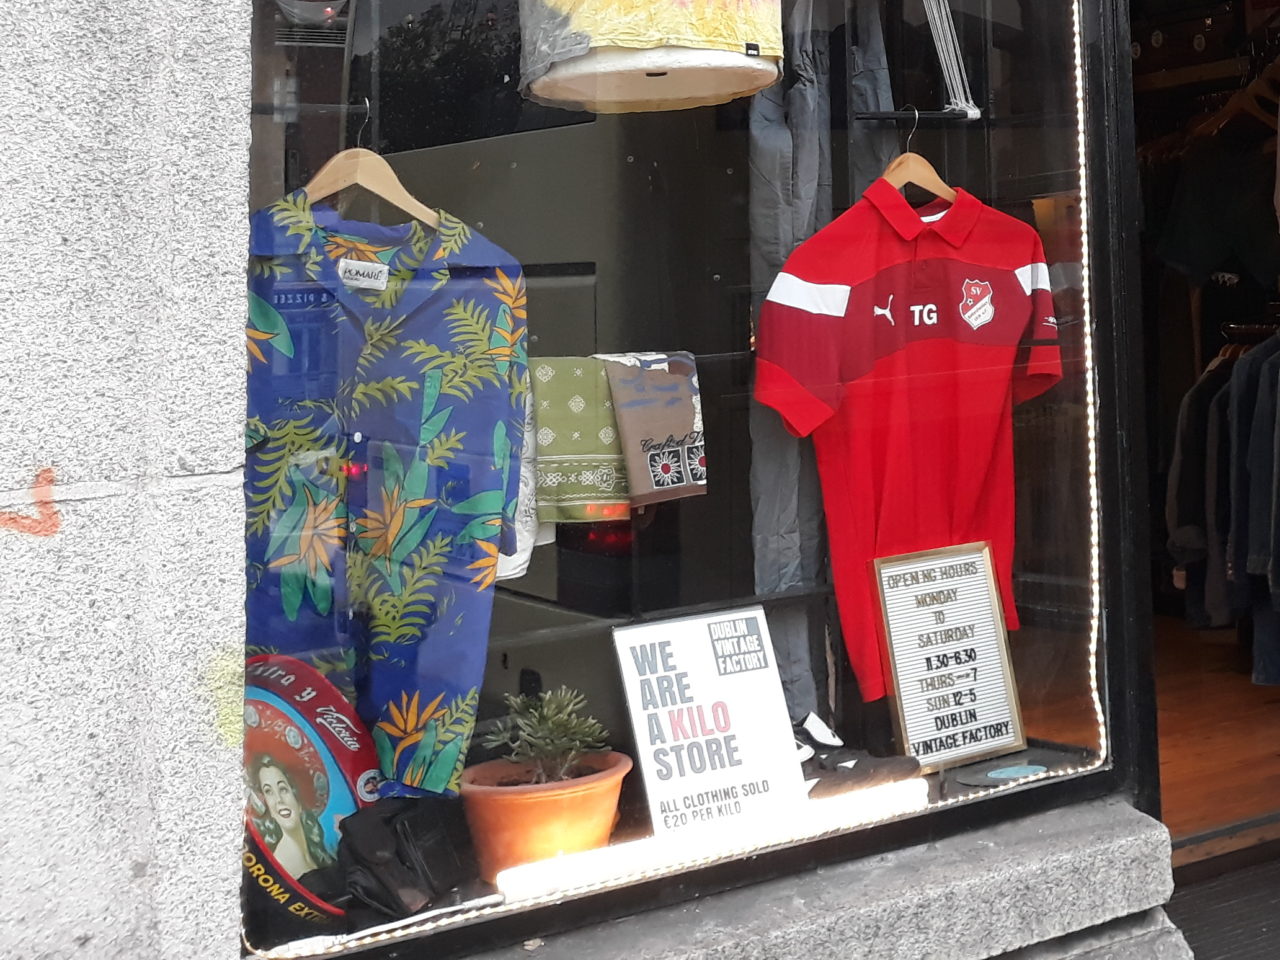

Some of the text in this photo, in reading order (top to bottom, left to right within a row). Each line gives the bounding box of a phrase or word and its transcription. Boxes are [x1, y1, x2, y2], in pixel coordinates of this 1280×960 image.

[970, 286, 983, 296] SV
[909, 304, 938, 326] TG
[939, 561, 978, 580] HOURS
[915, 588, 958, 609] MONDAY
[709, 618, 748, 640] DUBLIN
[932, 610, 946, 625] TO
[712, 634, 761, 656] VINTAGE
[917, 624, 975, 648] SATURDAY
[629, 640, 678, 677] WE
[717, 650, 767, 675] FACTORY
[639, 671, 694, 711] ARE
[926, 688, 977, 712] SUN 12-5
[646, 700, 732, 746] A KILO
[934, 708, 978, 731] DUBLIN
[912, 721, 1010, 756] VINTAGE FACTORY
[652, 734, 743, 781] STORE
[659, 779, 770, 815] ALL CLOTHING SOLD
[663, 800, 742, 830] €20 PER KILO
